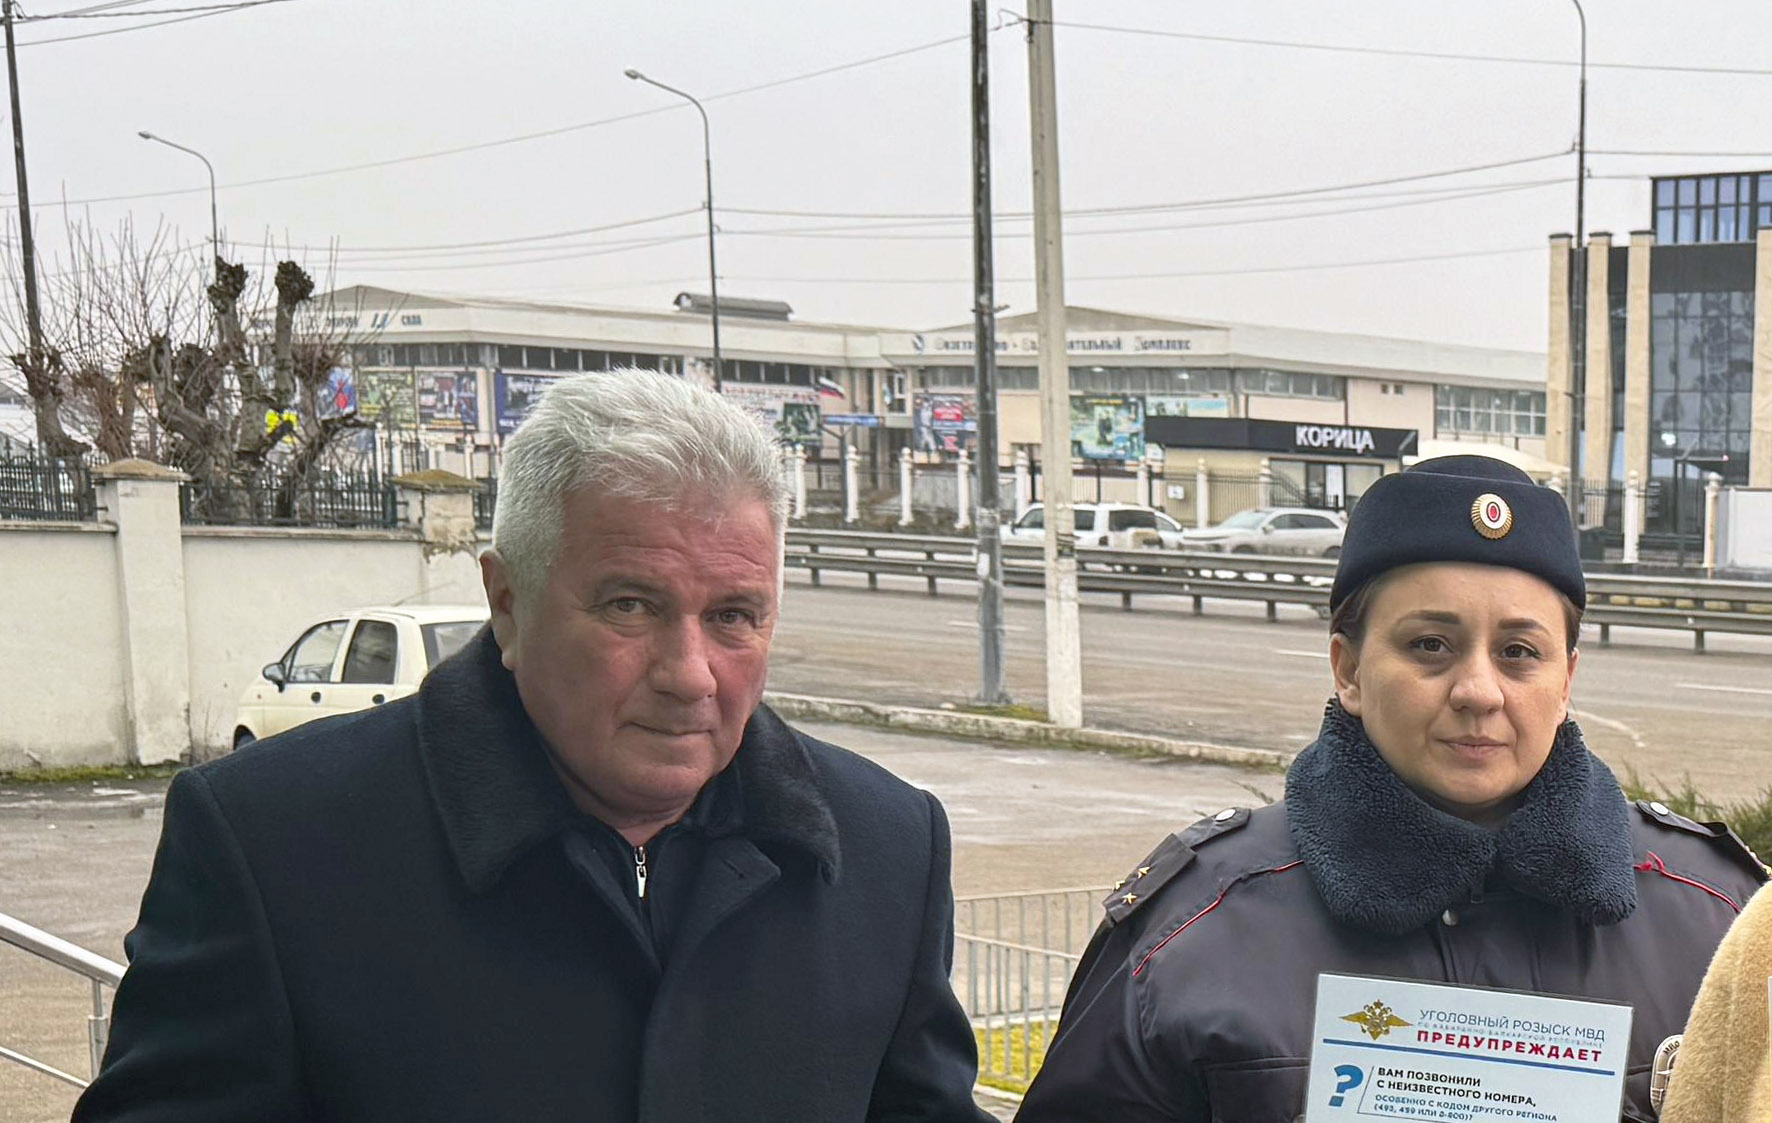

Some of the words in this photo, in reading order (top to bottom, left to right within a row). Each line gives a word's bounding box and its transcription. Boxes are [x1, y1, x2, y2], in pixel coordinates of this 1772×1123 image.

[1295, 424, 1374, 454] КОРИЦА
[1419, 1007, 1509, 1029] УГОЛОВНЫЙ
[1512, 1020, 1570, 1036] РОЗЫСК
[1574, 1027, 1605, 1041] МВД
[1417, 1030, 1601, 1063] ПРЕДУПРЕЖДАЕТ
[1378, 1066, 1403, 1078] ВАМ
[1406, 1069, 1480, 1087] ПОЗВОНИЛИ
[1375, 1093, 1425, 1106] ОСОБЕННО
[1436, 1100, 1469, 1111] КОДОМ
[1472, 1105, 1513, 1117] ДРУГОГО
[1516, 1110, 1557, 1121] РЕГИОНА
[1377, 1079, 1384, 1087] С
[1387, 1079, 1480, 1100] НЕИЗВЕСТНОГО
[1484, 1091, 1536, 1107] НОМЕРА,
